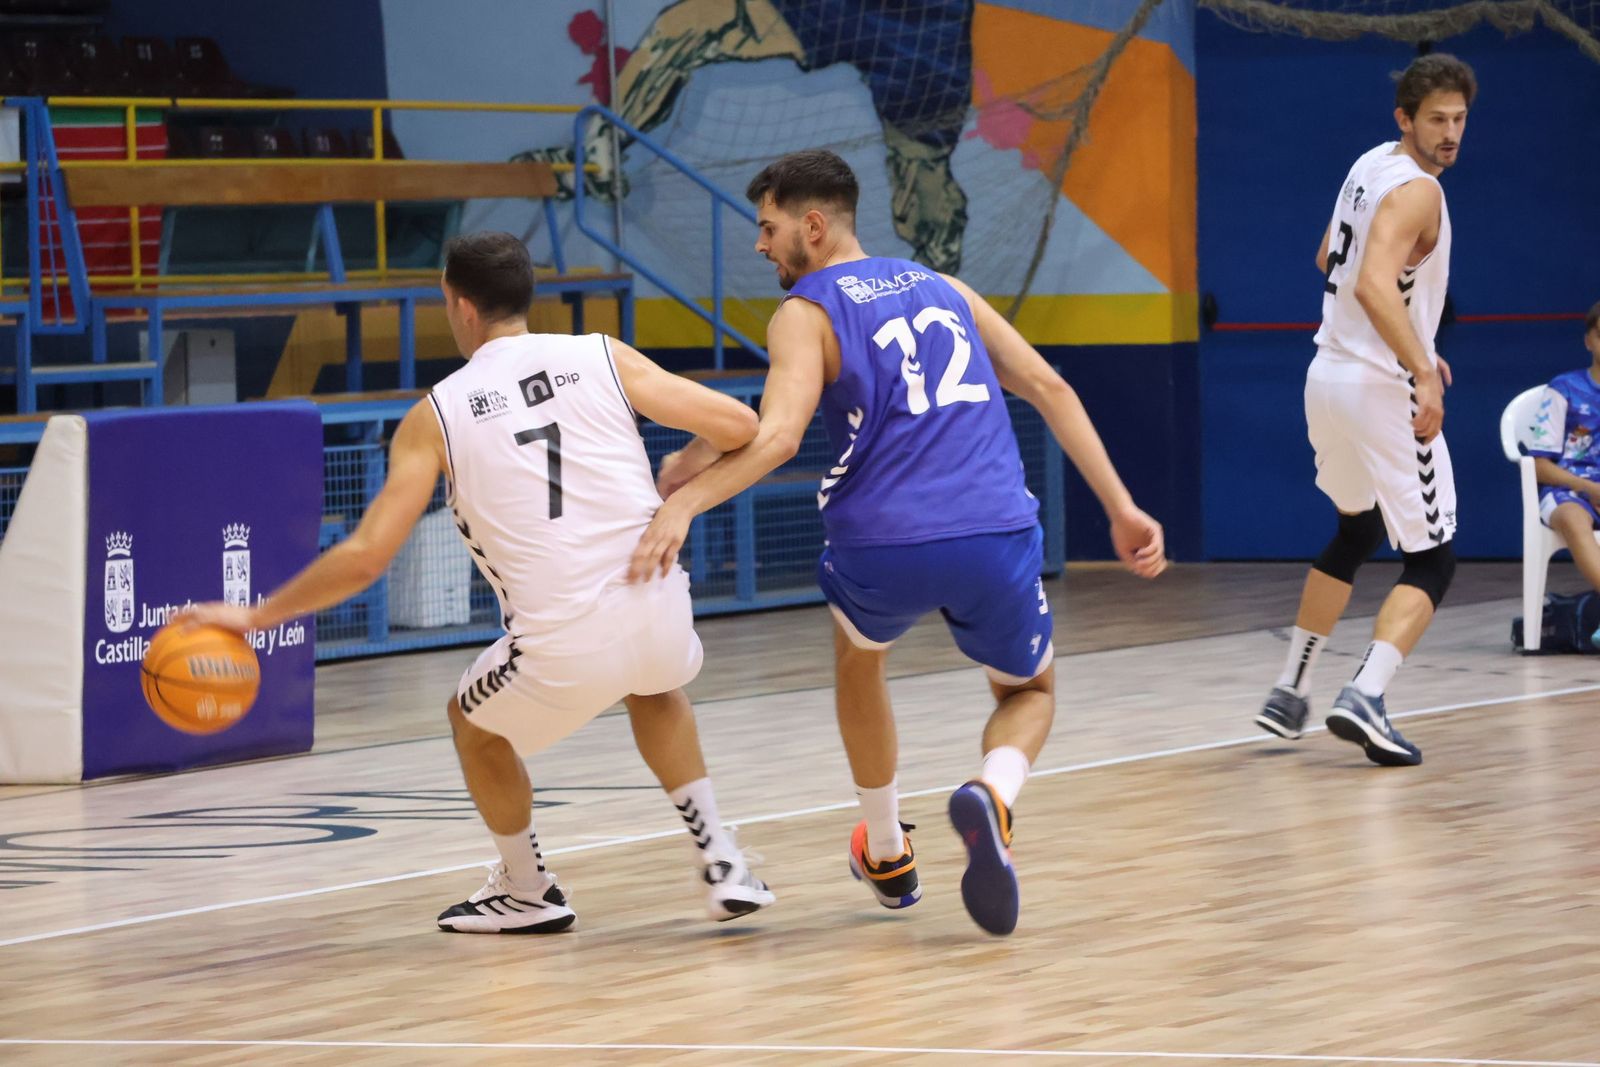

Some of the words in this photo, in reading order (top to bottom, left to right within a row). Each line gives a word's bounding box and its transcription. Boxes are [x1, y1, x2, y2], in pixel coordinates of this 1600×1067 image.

[554, 371, 580, 388] Dip
[872, 306, 991, 415] 12
[513, 421, 563, 520] 7
[267, 629, 277, 656] y
[278, 621, 305, 647] León
